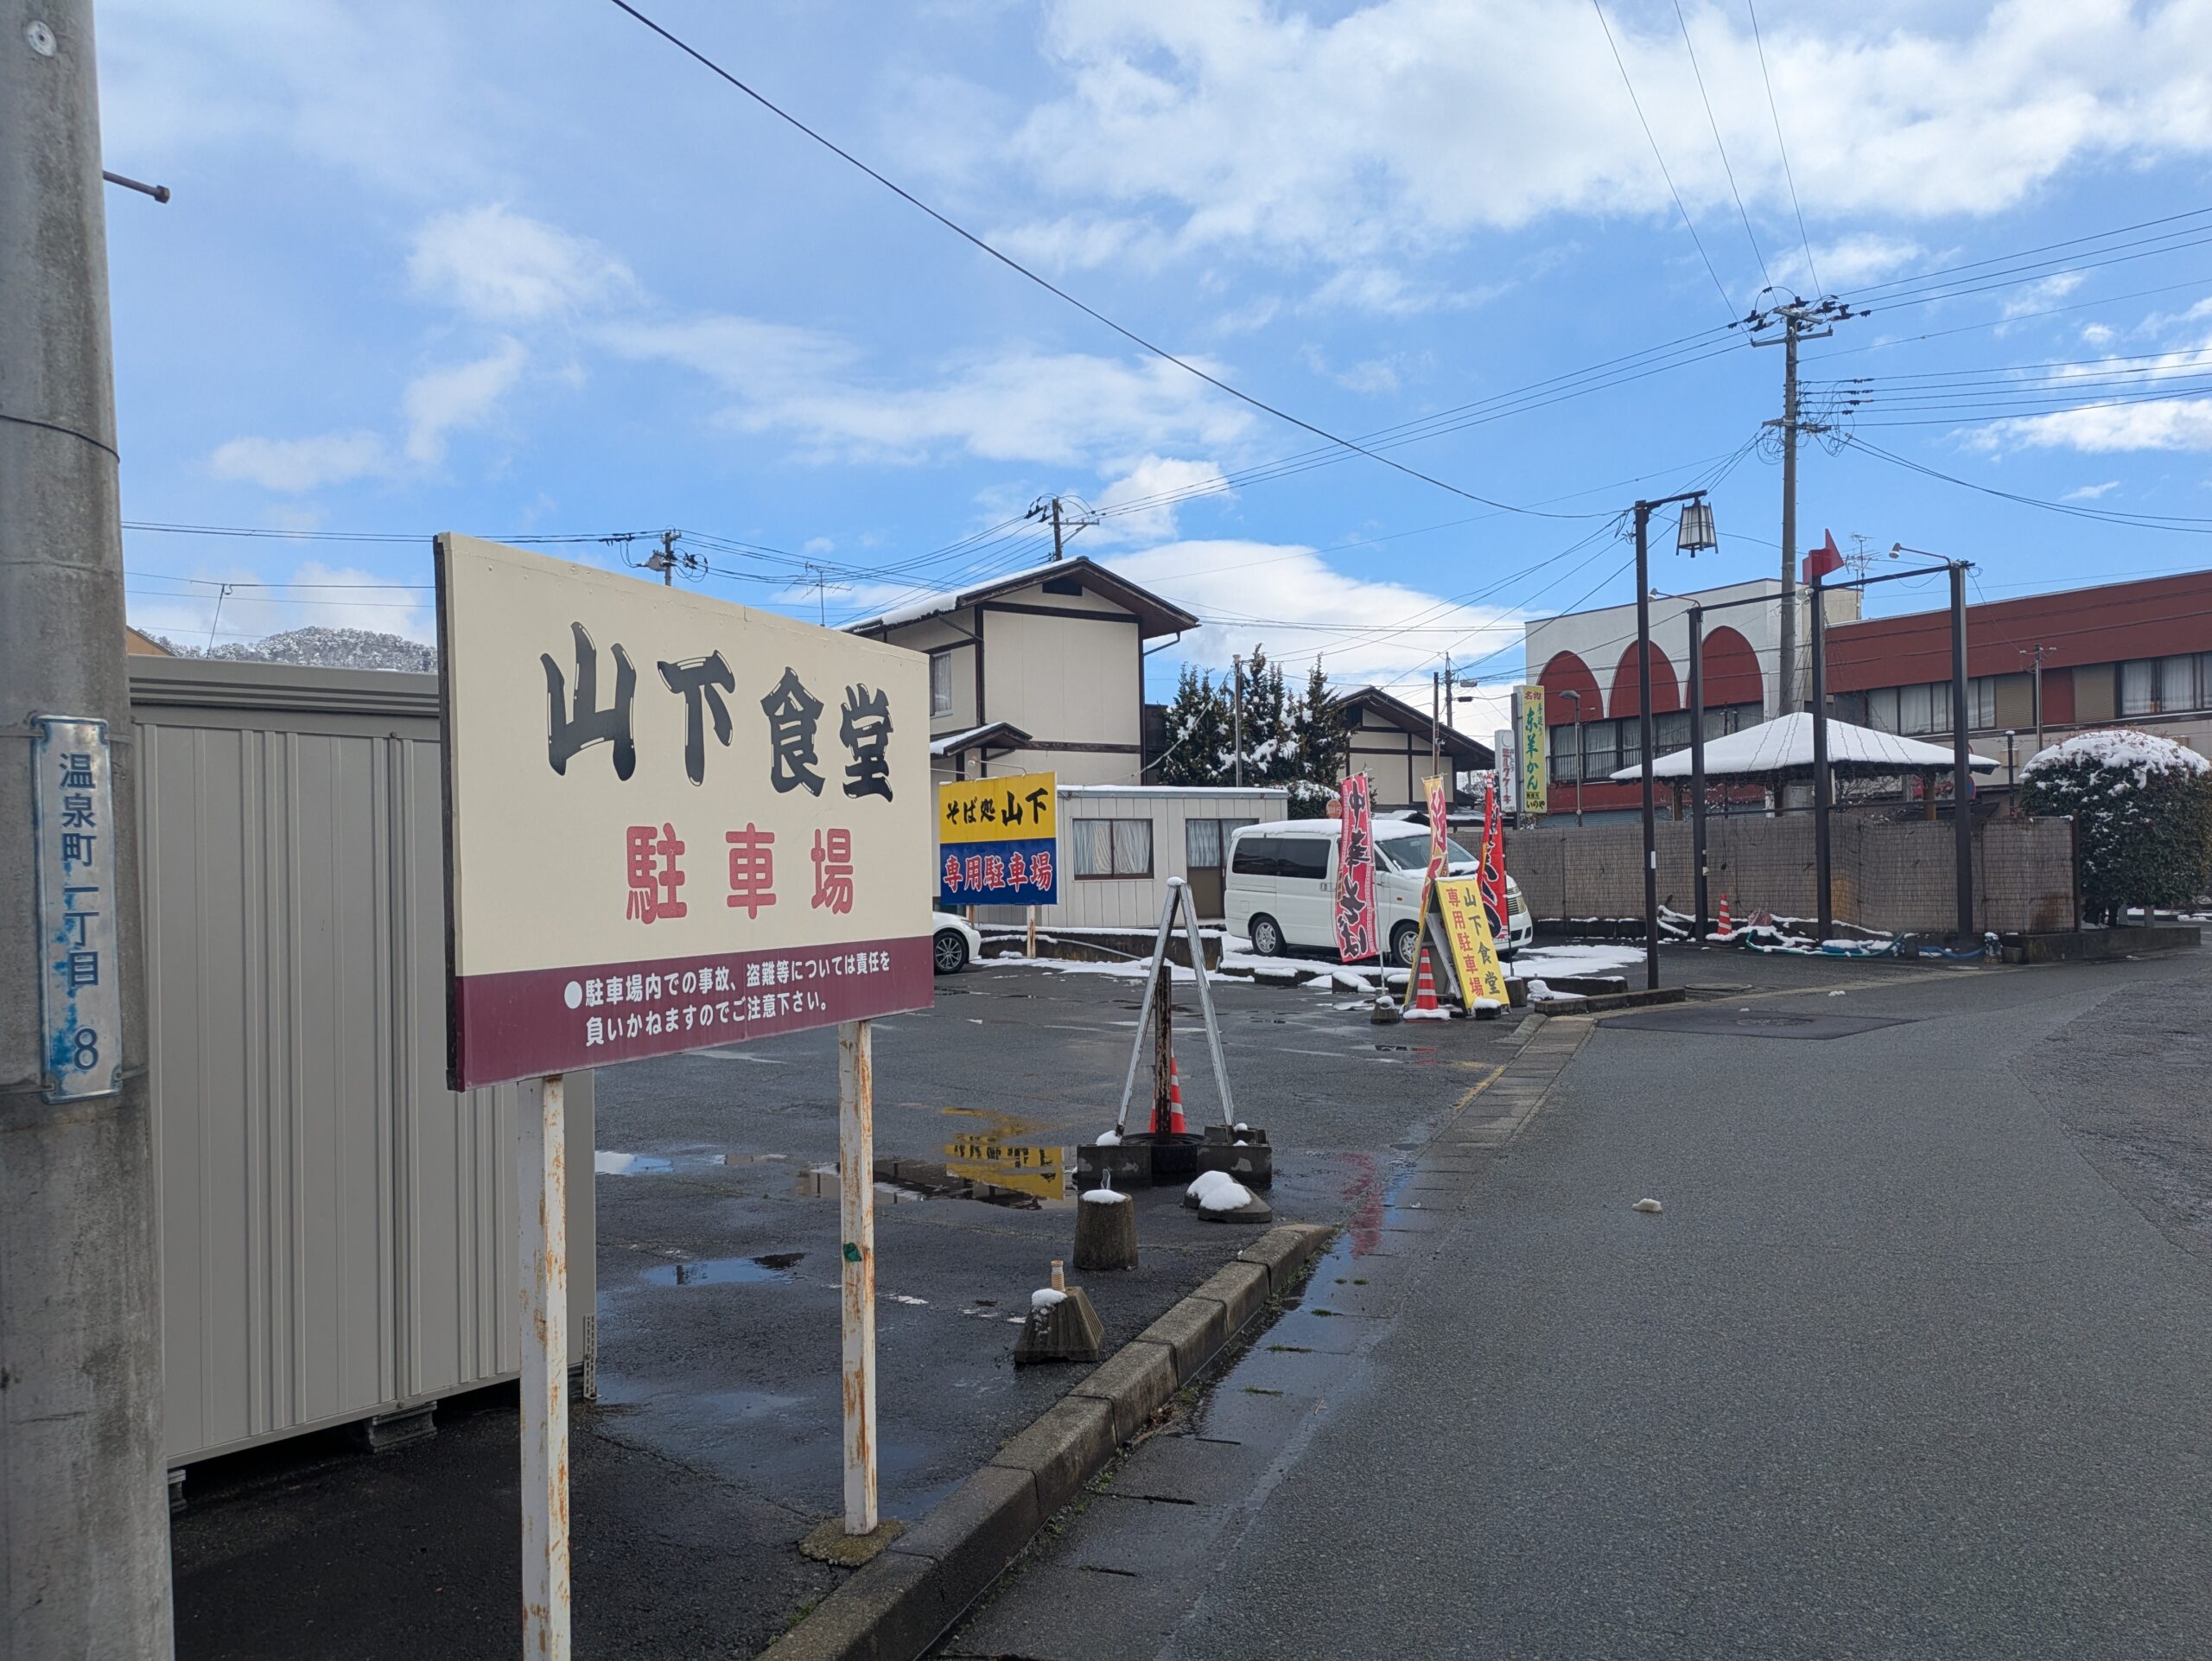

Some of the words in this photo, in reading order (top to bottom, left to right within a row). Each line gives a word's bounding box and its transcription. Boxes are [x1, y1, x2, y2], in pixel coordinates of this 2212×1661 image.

[540, 620, 894, 803] 山下食堂
[1524, 690, 1542, 702] 名物
[1502, 748, 1512, 805] ミルクケーキ
[58, 752, 100, 987] 温泉町一丁目
[626, 822, 854, 925] 駐車場
[944, 851, 1052, 893] 専用駐車場
[1446, 888, 1484, 996] 専用駐車場
[1463, 887, 1500, 995] 山下食堂
[73, 1028, 99, 1072] 8
[585, 991, 828, 1047] 負いかねますのでご注意下さい。
